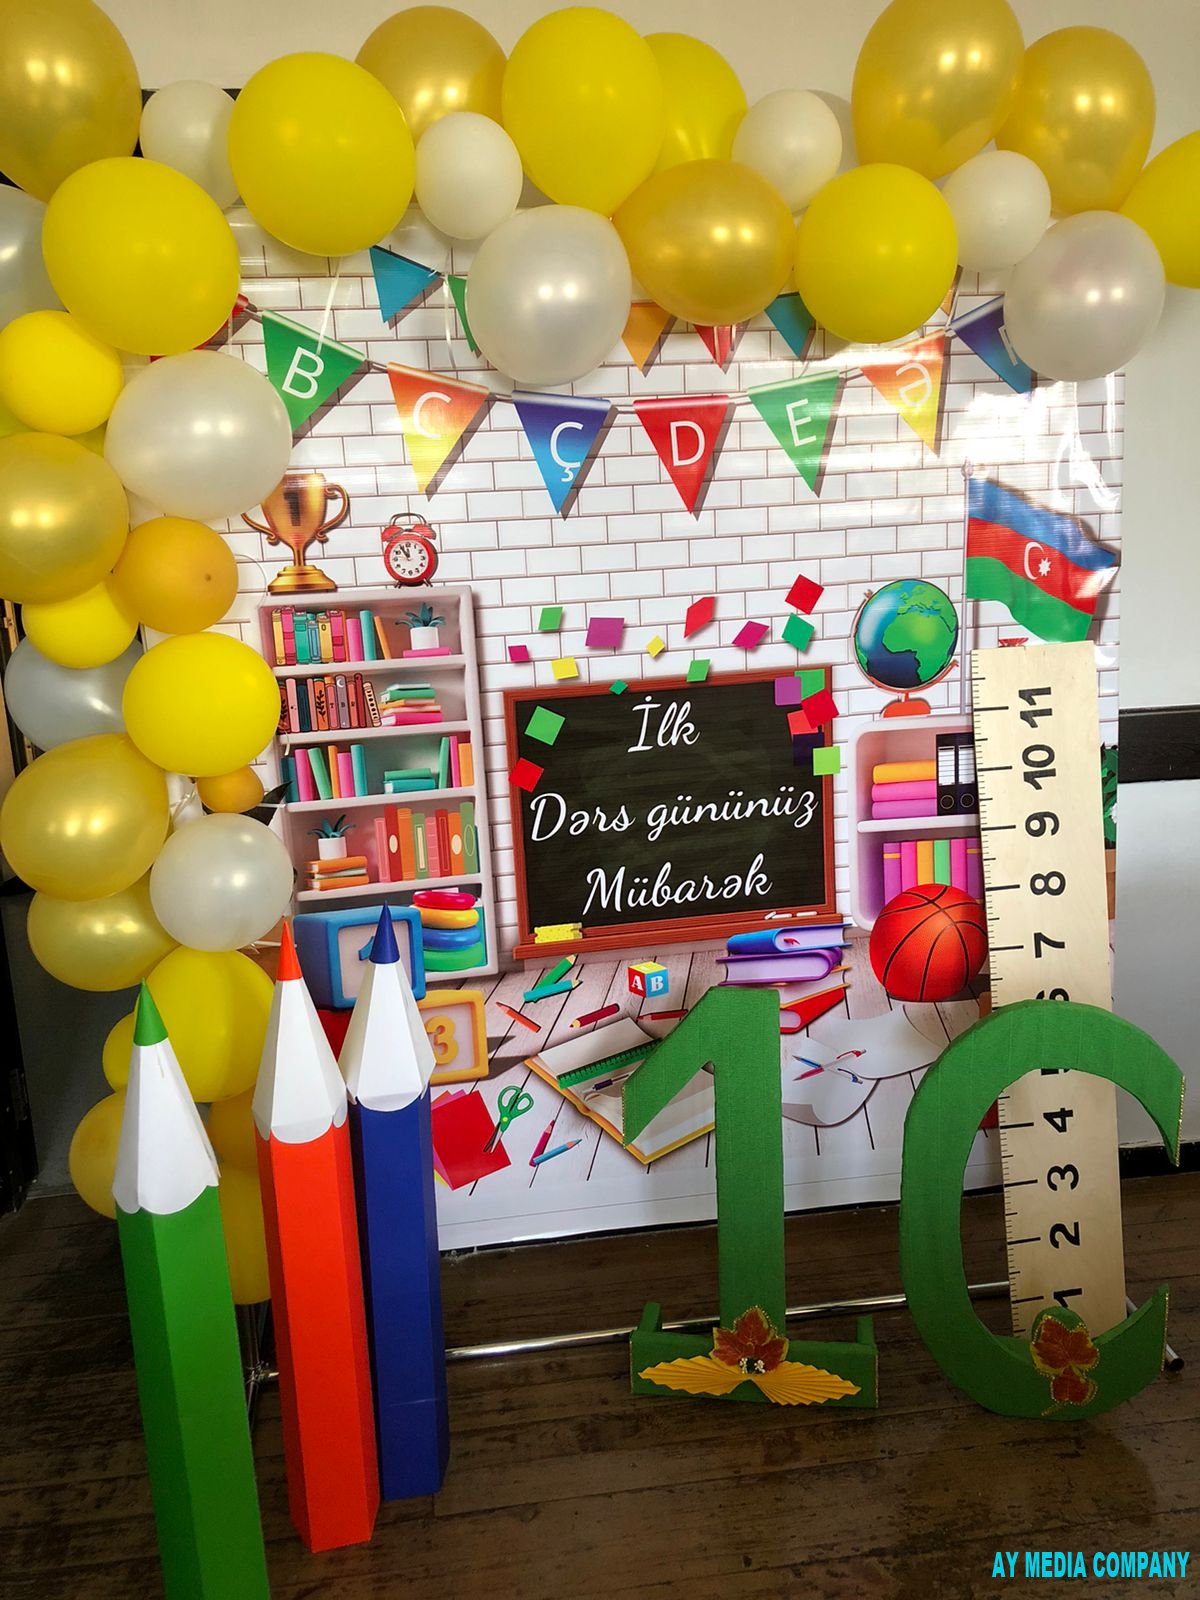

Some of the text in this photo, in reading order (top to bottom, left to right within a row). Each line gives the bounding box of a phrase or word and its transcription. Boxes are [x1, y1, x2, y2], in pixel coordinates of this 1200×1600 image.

[281, 346, 326, 400] B
[412, 391, 452, 440] C
[549, 421, 584, 483] Ç
[670, 420, 705, 468] D
[785, 397, 817, 447] E
[627, 695, 700, 752] İlk
[1018, 686, 1053, 729] 11
[1021, 743, 1057, 790] 10
[529, 785, 819, 842] Dərs gününüz
[1025, 811, 1060, 837] 9
[582, 853, 773, 916] Mübarək
[1029, 870, 1066, 896] 8
[1033, 932, 1066, 958] 7
[631, 975, 664, 993] A B
[424, 1015, 460, 1065] 3
[1042, 1107, 1074, 1133] 4
[1046, 1163, 1080, 1191] 3
[1049, 1221, 1080, 1249] 2
